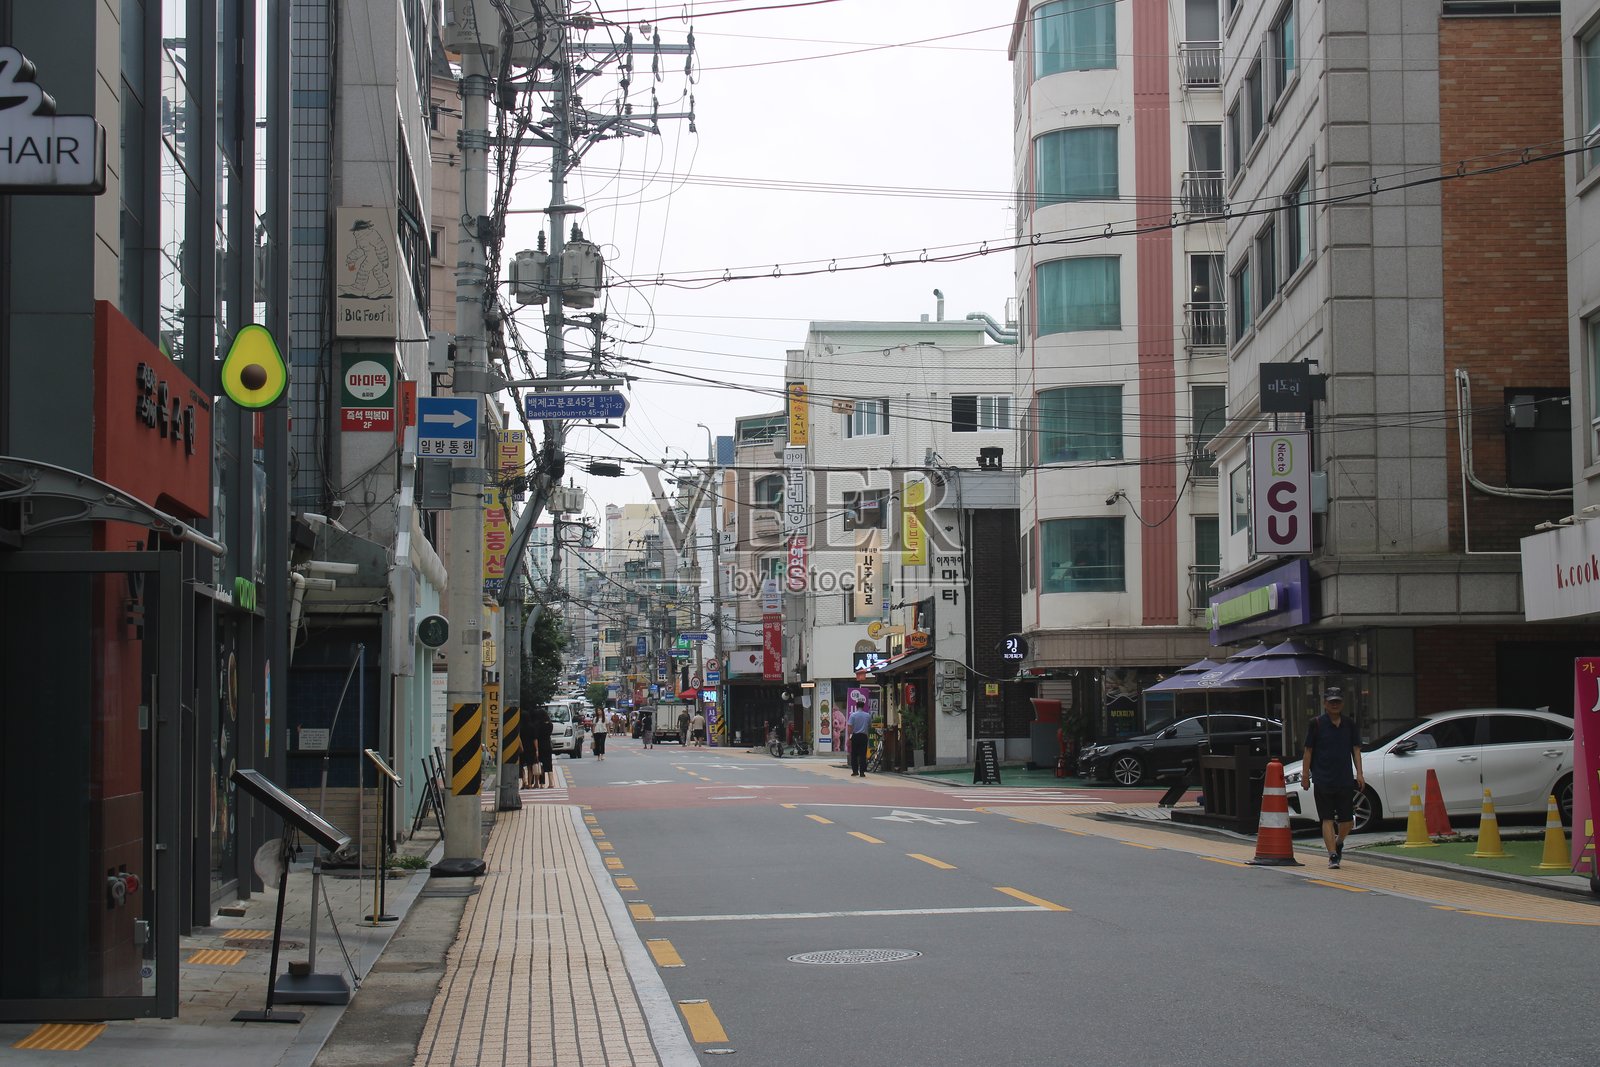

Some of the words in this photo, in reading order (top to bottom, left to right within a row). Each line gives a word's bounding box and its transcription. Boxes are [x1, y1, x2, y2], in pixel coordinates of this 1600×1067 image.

[345, 308, 361, 322] BIG
[364, 309, 385, 321] FOOT
[349, 374, 387, 387] 마미떡
[1267, 378, 1300, 396] 미도인
[528, 396, 595, 409] 백제고분로45길
[528, 409, 586, 419] Baekjegobun-ro
[588, 408, 609, 418] 45-gil
[363, 421, 373, 429] 2F
[498, 431, 523, 443] 대한
[421, 439, 473, 454] 일방통행
[1277, 443, 1286, 462] Nice
[1277, 464, 1286, 472] to
[1267, 481, 1298, 545] CU
[486, 508, 506, 574] 부동산
[1006, 638, 1018, 653] 킹
